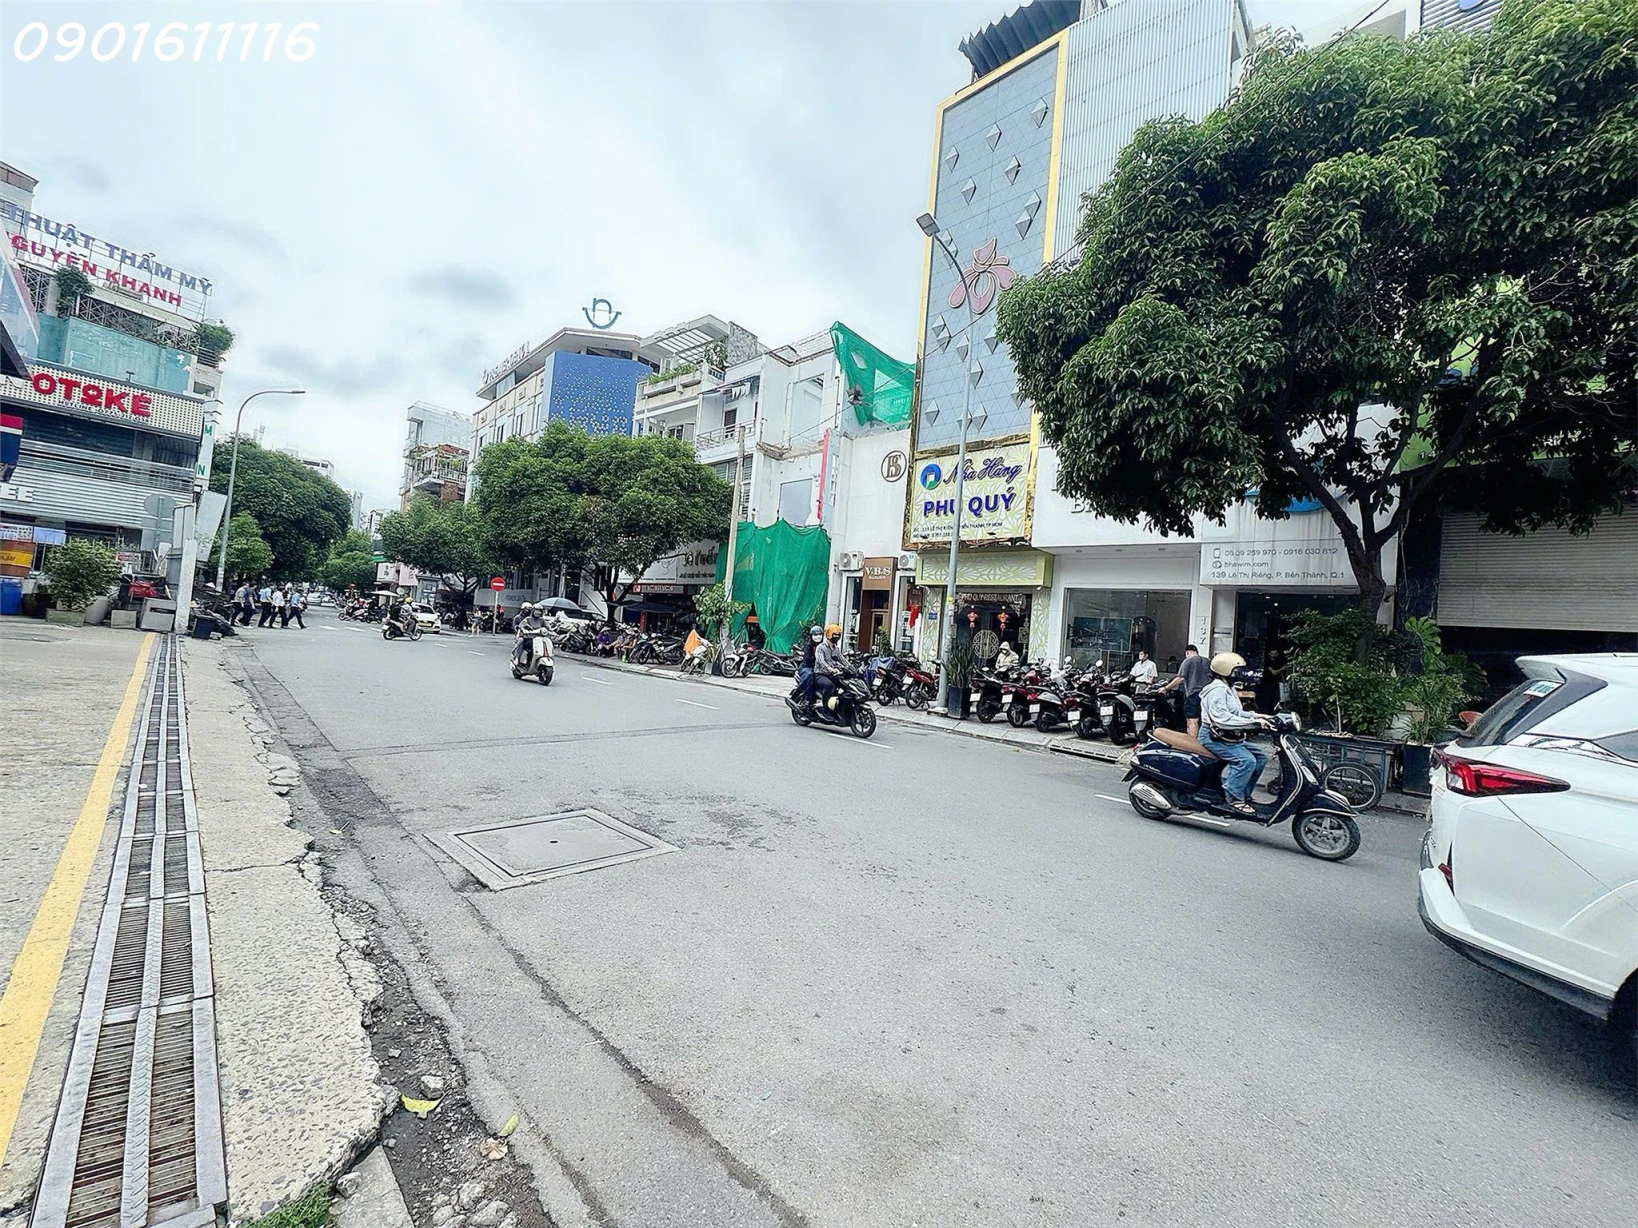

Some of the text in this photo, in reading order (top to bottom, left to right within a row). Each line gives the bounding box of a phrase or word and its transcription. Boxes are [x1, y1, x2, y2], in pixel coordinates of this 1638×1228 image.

[6, 231, 182, 307] GUYỄN KHANH
[977, 457, 1022, 484] Hàng
[968, 486, 1017, 518] QUÝ
